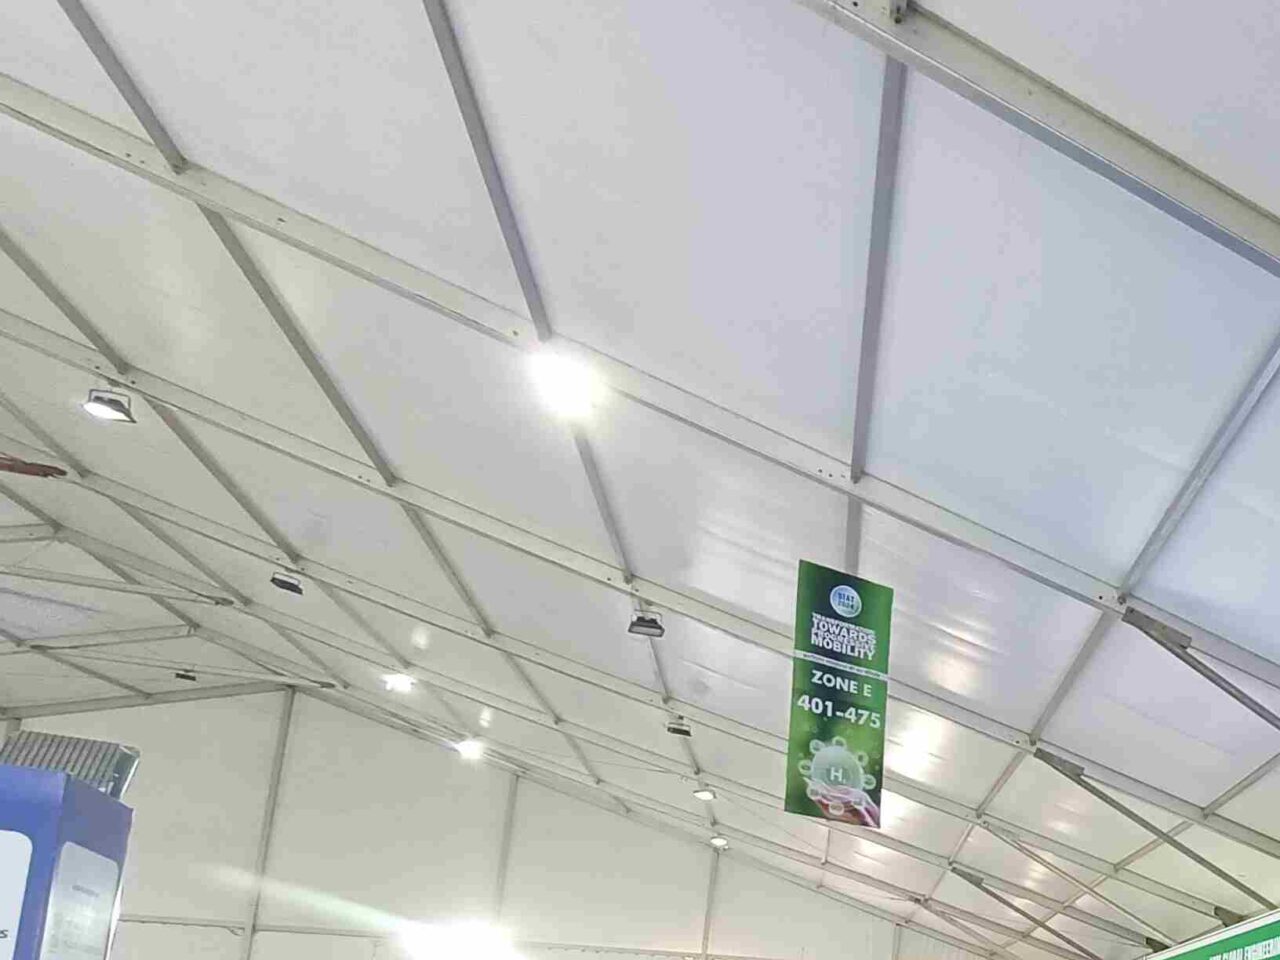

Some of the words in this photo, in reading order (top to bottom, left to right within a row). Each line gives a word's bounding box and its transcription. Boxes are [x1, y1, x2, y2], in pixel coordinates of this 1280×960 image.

[813, 619, 877, 644] TOWARDS
[811, 636, 876, 660] MOBILITY
[811, 670, 858, 694] ZONE
[863, 684, 872, 697] E
[797, 695, 881, 728] 401-475
